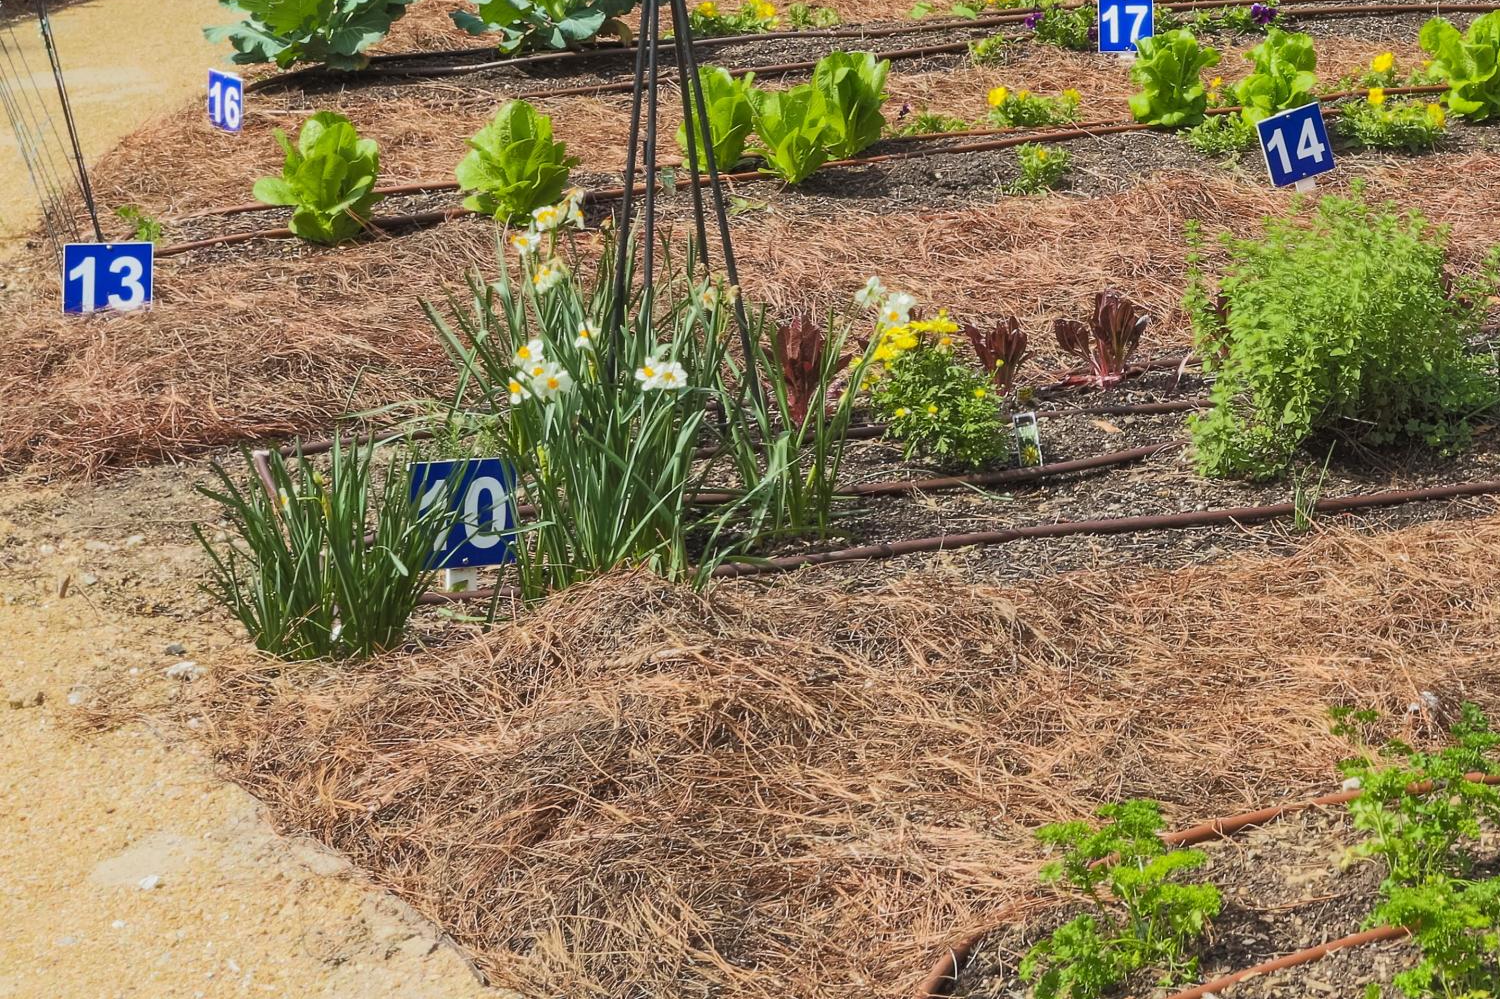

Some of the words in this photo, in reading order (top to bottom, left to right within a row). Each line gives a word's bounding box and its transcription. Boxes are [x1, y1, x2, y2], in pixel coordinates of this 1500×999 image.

[1102, 4, 1148, 43] 17
[210, 81, 240, 129] 16
[1267, 117, 1326, 174] 14
[69, 256, 145, 312] 13
